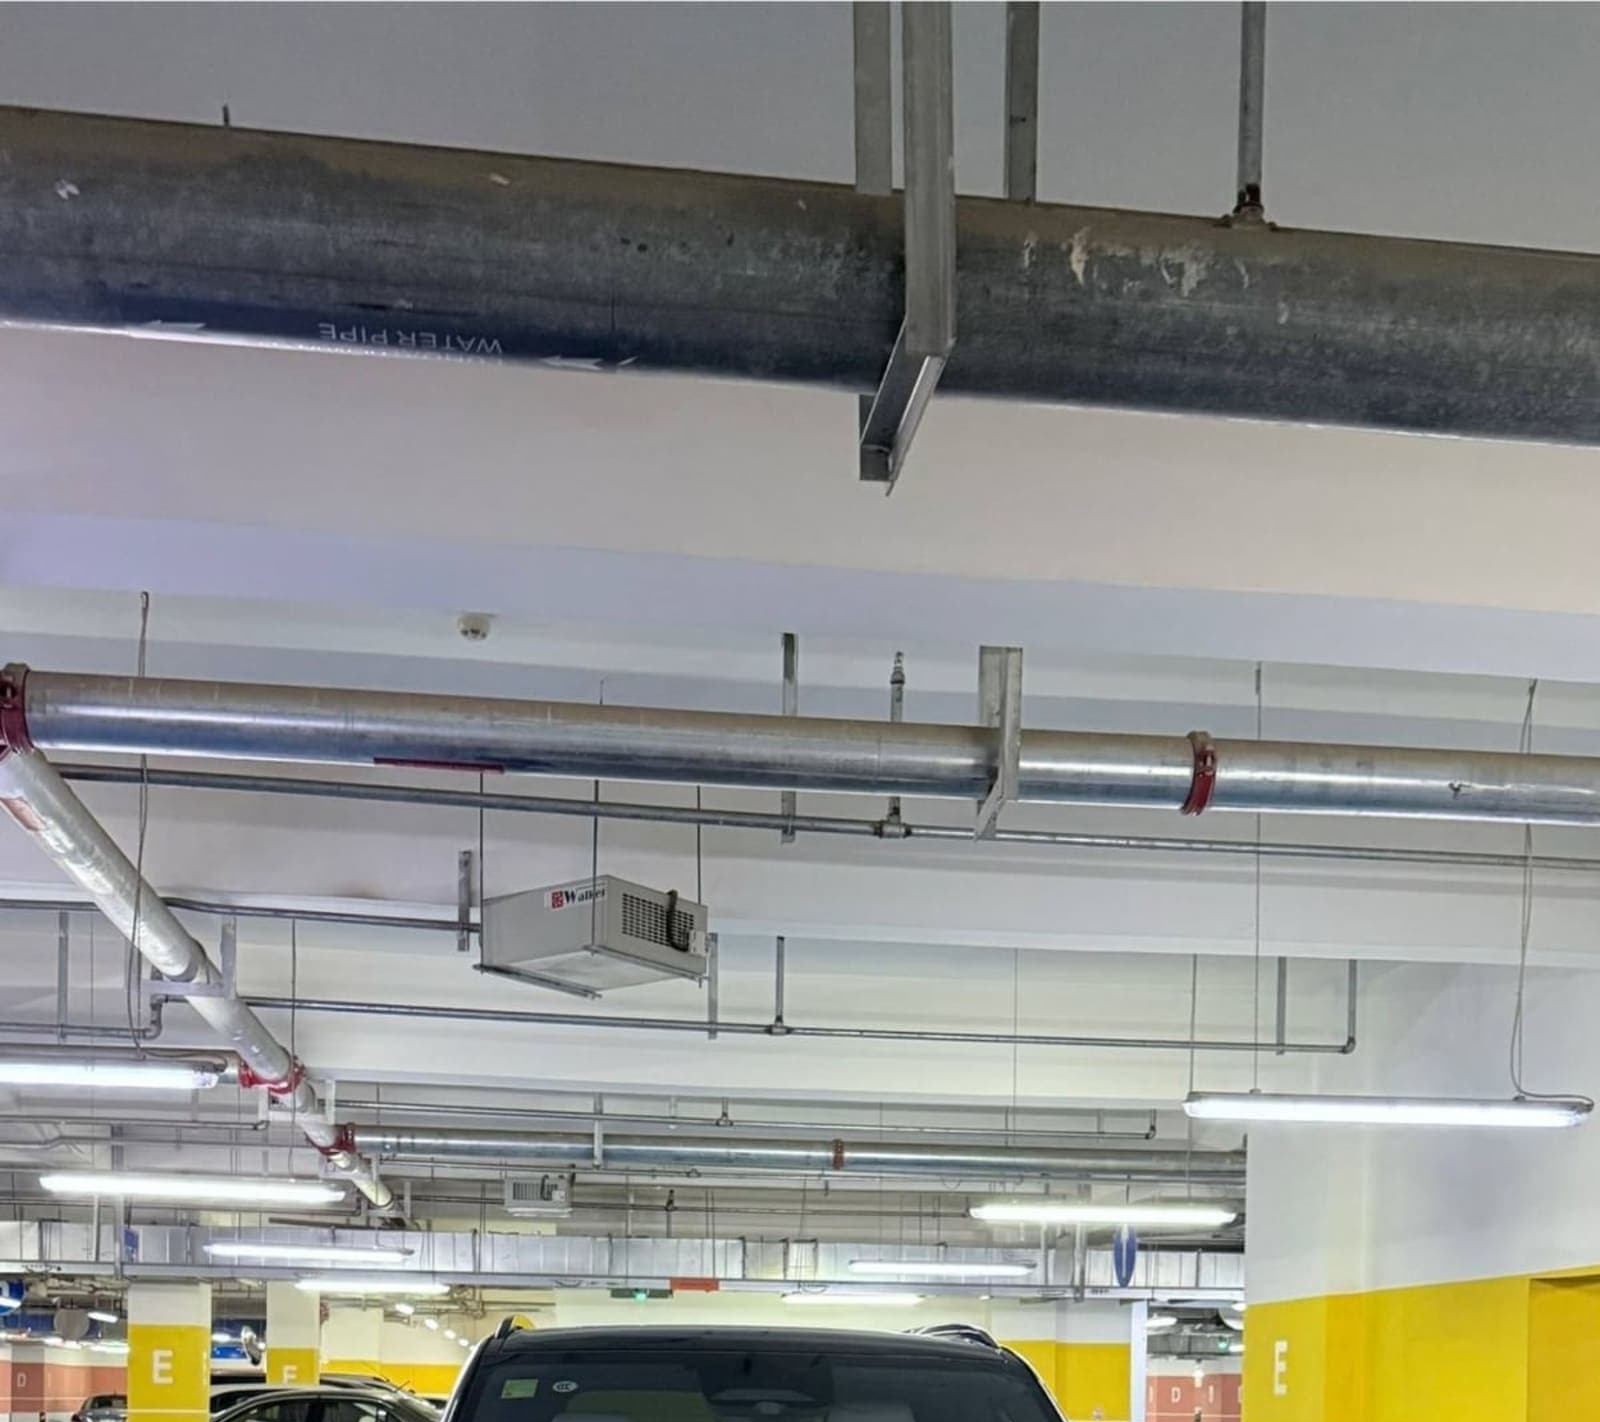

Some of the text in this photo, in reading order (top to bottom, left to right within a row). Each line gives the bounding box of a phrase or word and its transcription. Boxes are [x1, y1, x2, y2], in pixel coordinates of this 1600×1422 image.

[318, 322, 503, 353] WATER PIPE
[152, 1349, 174, 1385] E
[1274, 1340, 1288, 1396] E
